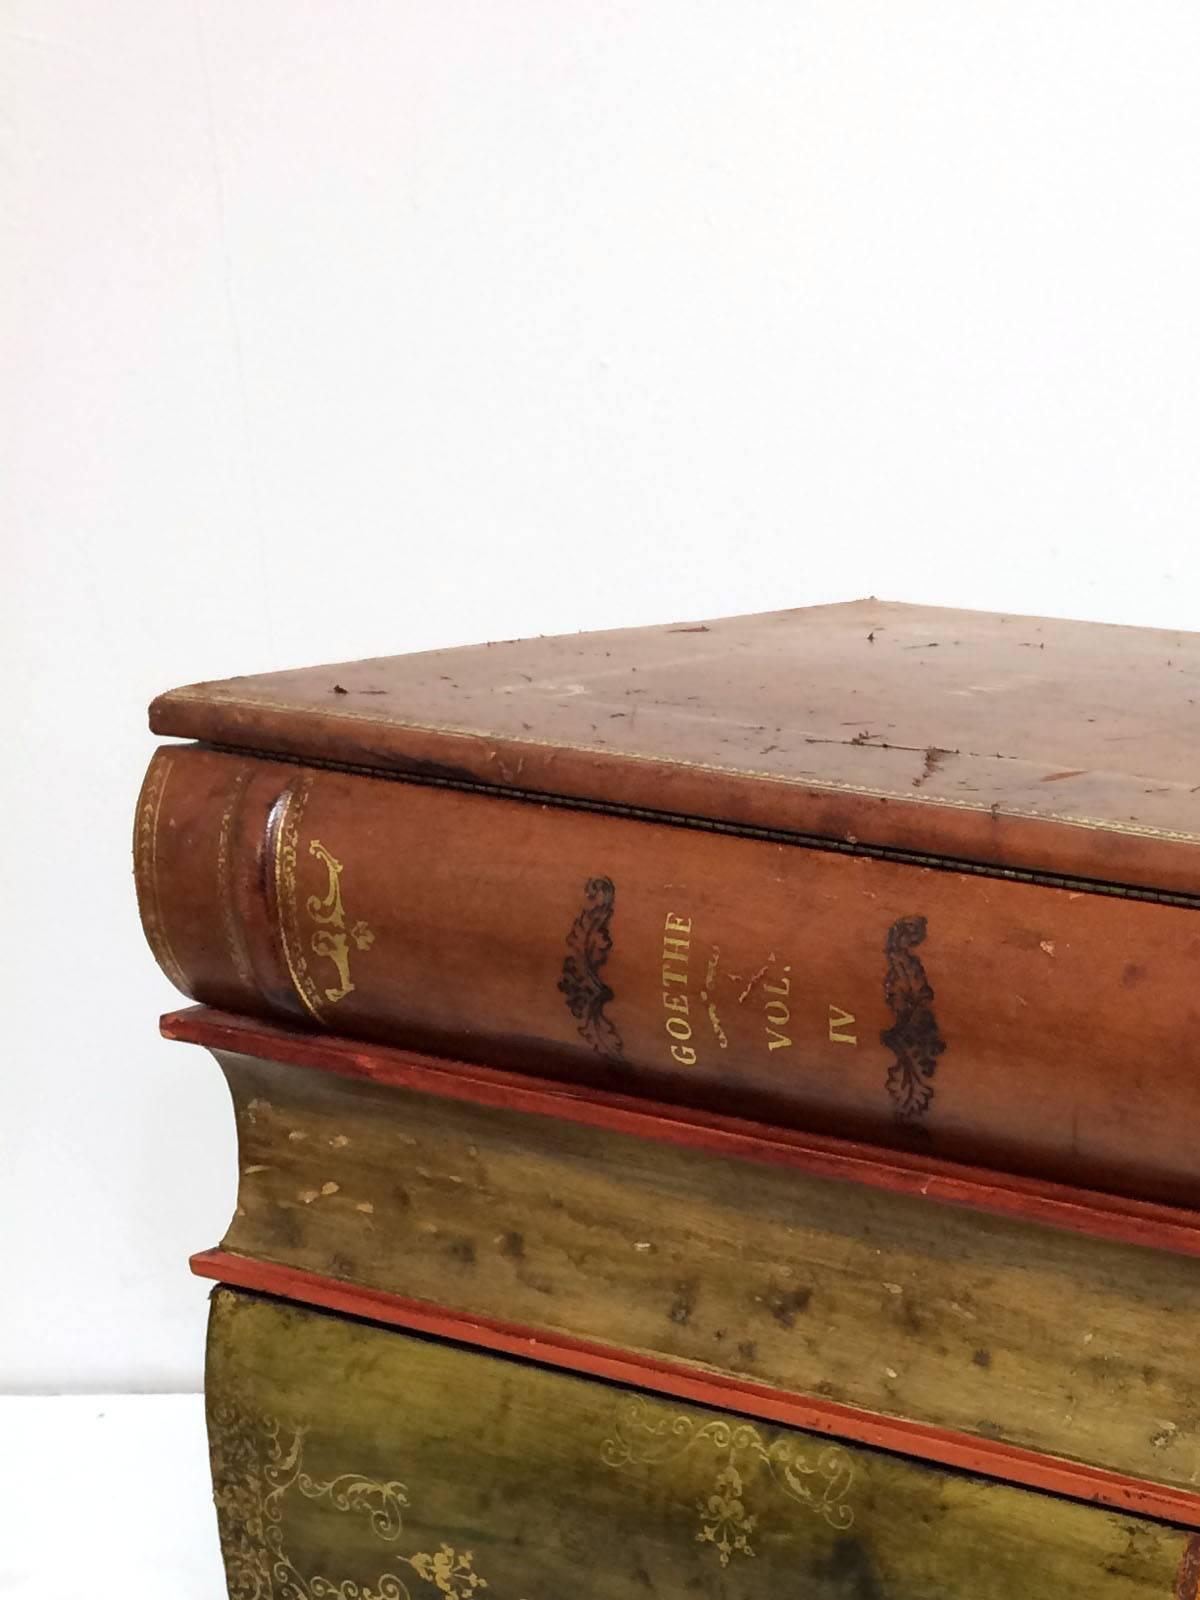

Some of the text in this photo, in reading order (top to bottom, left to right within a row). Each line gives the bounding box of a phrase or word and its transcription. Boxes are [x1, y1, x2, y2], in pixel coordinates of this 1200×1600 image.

[662, 911, 698, 1066] GOETHE
[763, 964, 793, 1052] VOL.
[828, 1004, 858, 1046] IV
